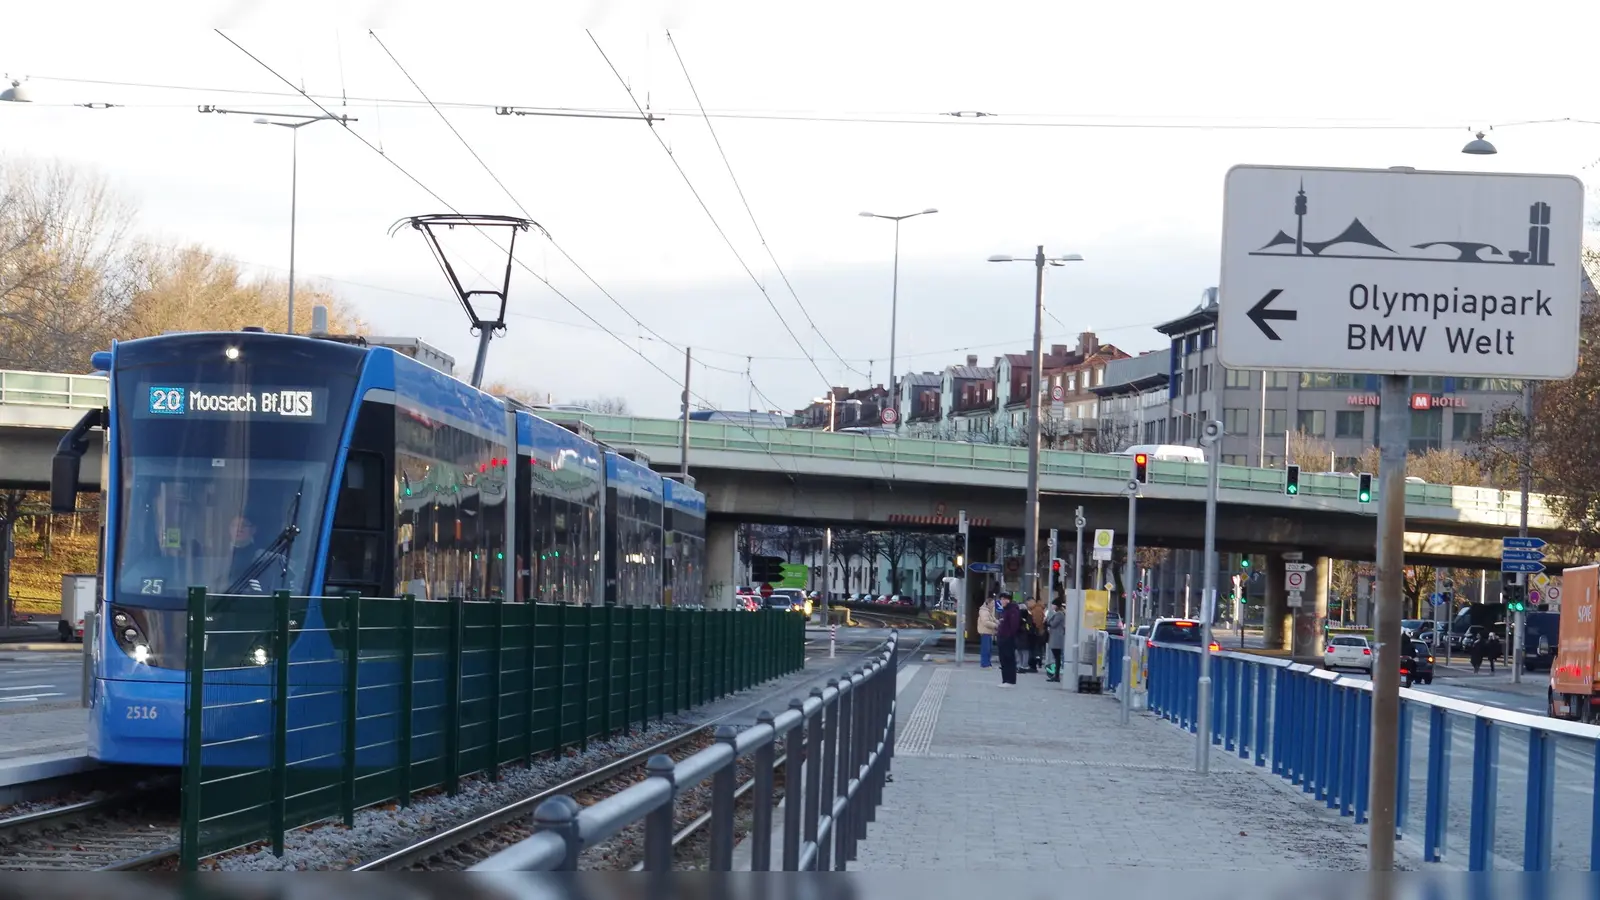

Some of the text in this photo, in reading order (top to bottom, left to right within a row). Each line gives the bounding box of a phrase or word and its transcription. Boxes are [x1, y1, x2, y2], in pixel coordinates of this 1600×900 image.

[1349, 284, 1552, 321] Olympiapark
[1347, 324, 1515, 355] BMW Welt
[152, 390, 181, 410] 20
[189, 391, 257, 411] Moosach
[1431, 396, 1468, 407] HOTEL
[141, 579, 164, 594] 25
[126, 706, 158, 719] 2516
